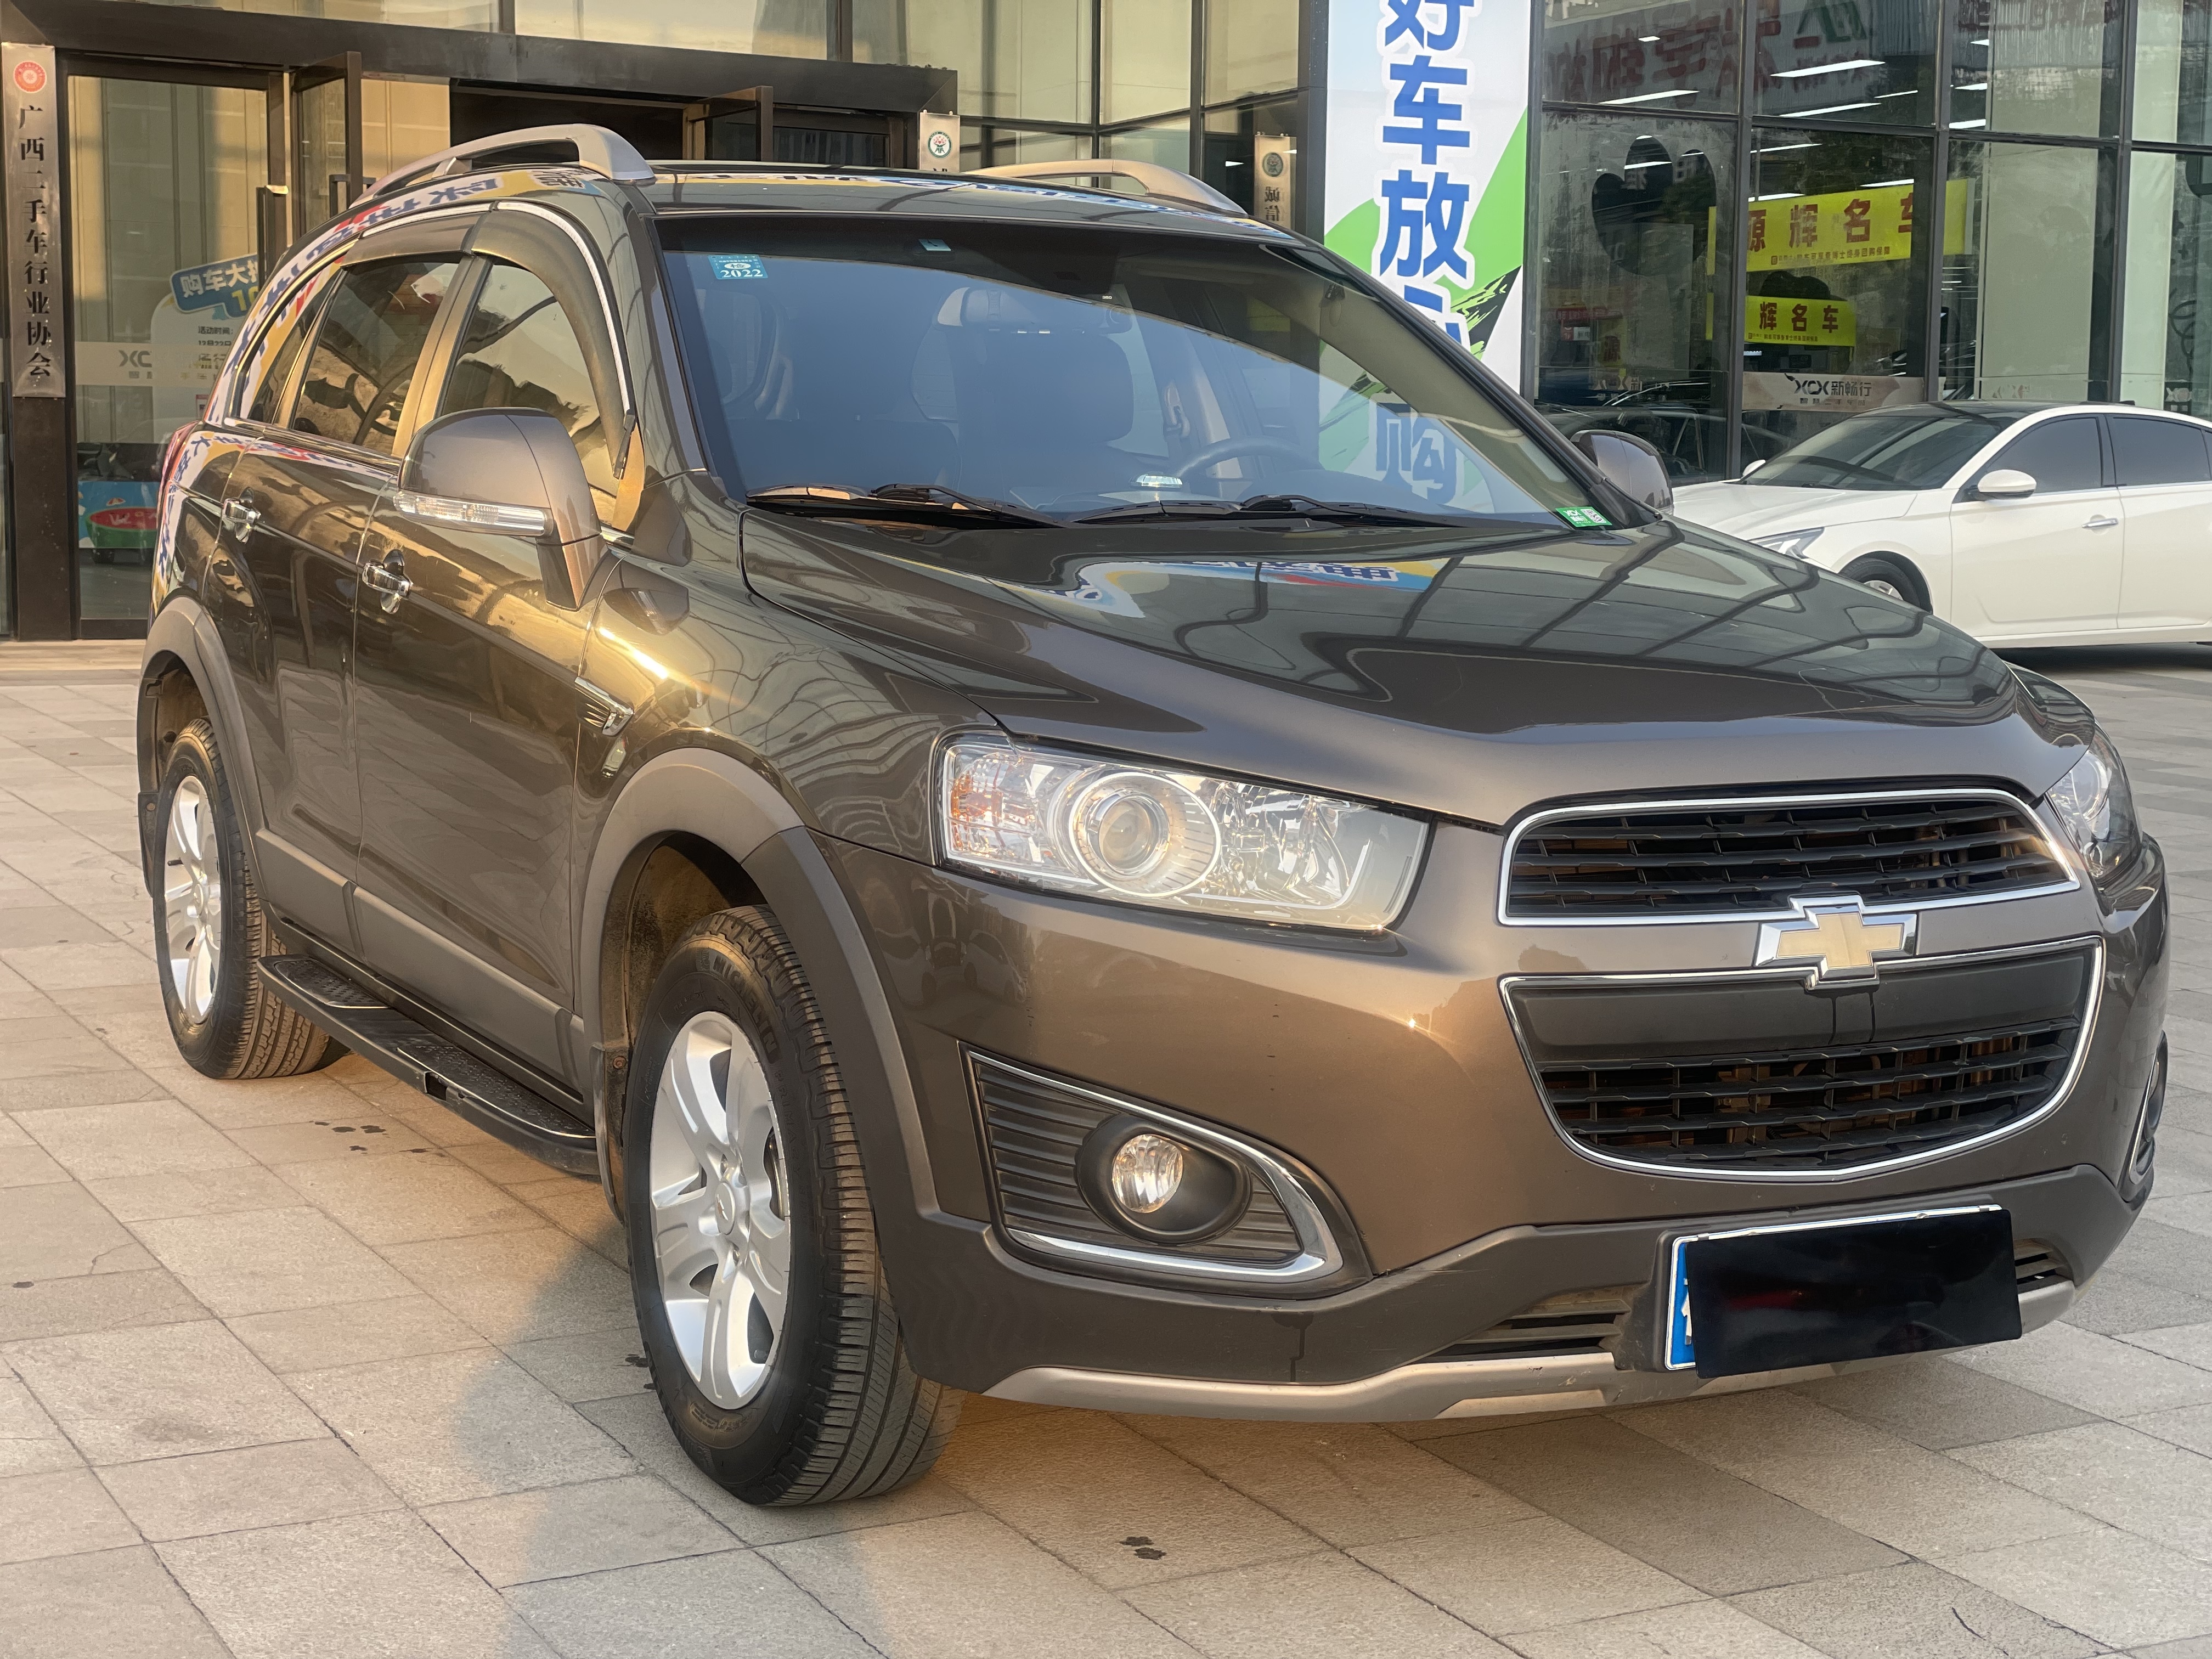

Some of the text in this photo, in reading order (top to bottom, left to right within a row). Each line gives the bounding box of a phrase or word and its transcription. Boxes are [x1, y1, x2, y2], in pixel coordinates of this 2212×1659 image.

[19, 105, 52, 376] 广西二手车行业协会
[720, 269, 763, 278] 2022
[1759, 301, 1838, 333] 辉名车
[713, 955, 782, 1063] MICHELIN
